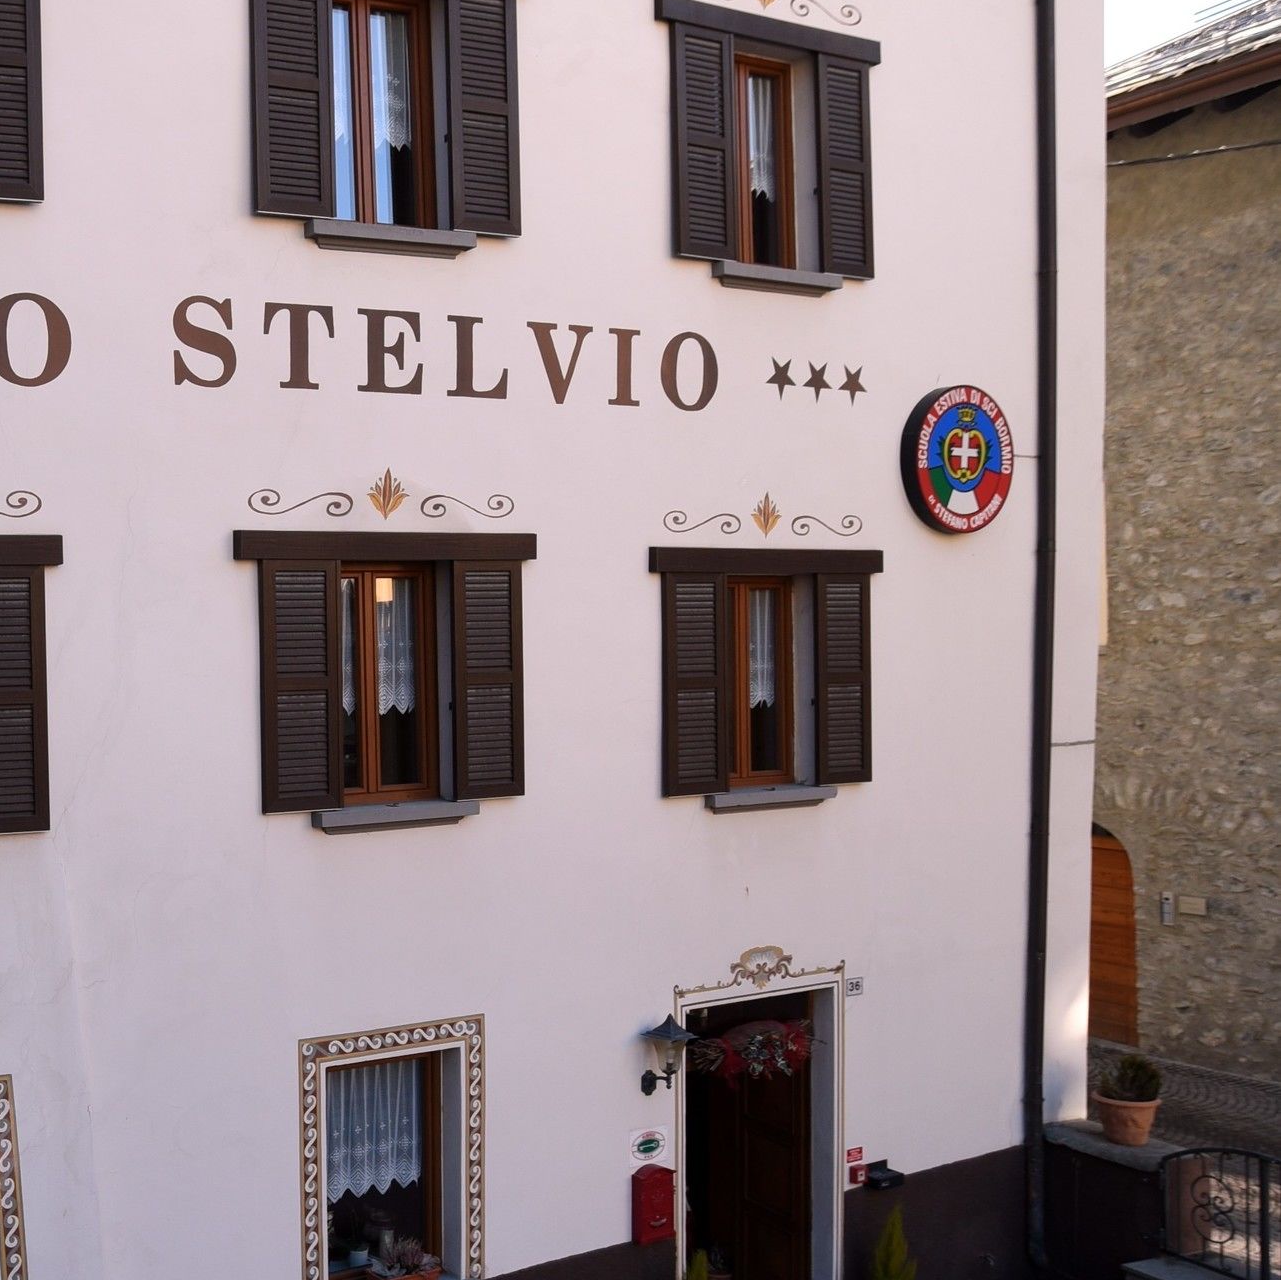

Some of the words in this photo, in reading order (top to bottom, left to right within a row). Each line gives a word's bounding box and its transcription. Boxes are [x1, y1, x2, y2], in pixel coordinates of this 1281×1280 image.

[172, 295, 719, 411] STELVIO
[918, 413, 938, 468] SCUOLA
[934, 388, 967, 415] ESTIVA
[970, 389, 981, 405] DI
[981, 396, 998, 419] SCI
[994, 417, 1011, 474] BORMIO
[934, 503, 968, 530] STEFANO
[848, 980, 861, 992] 36
